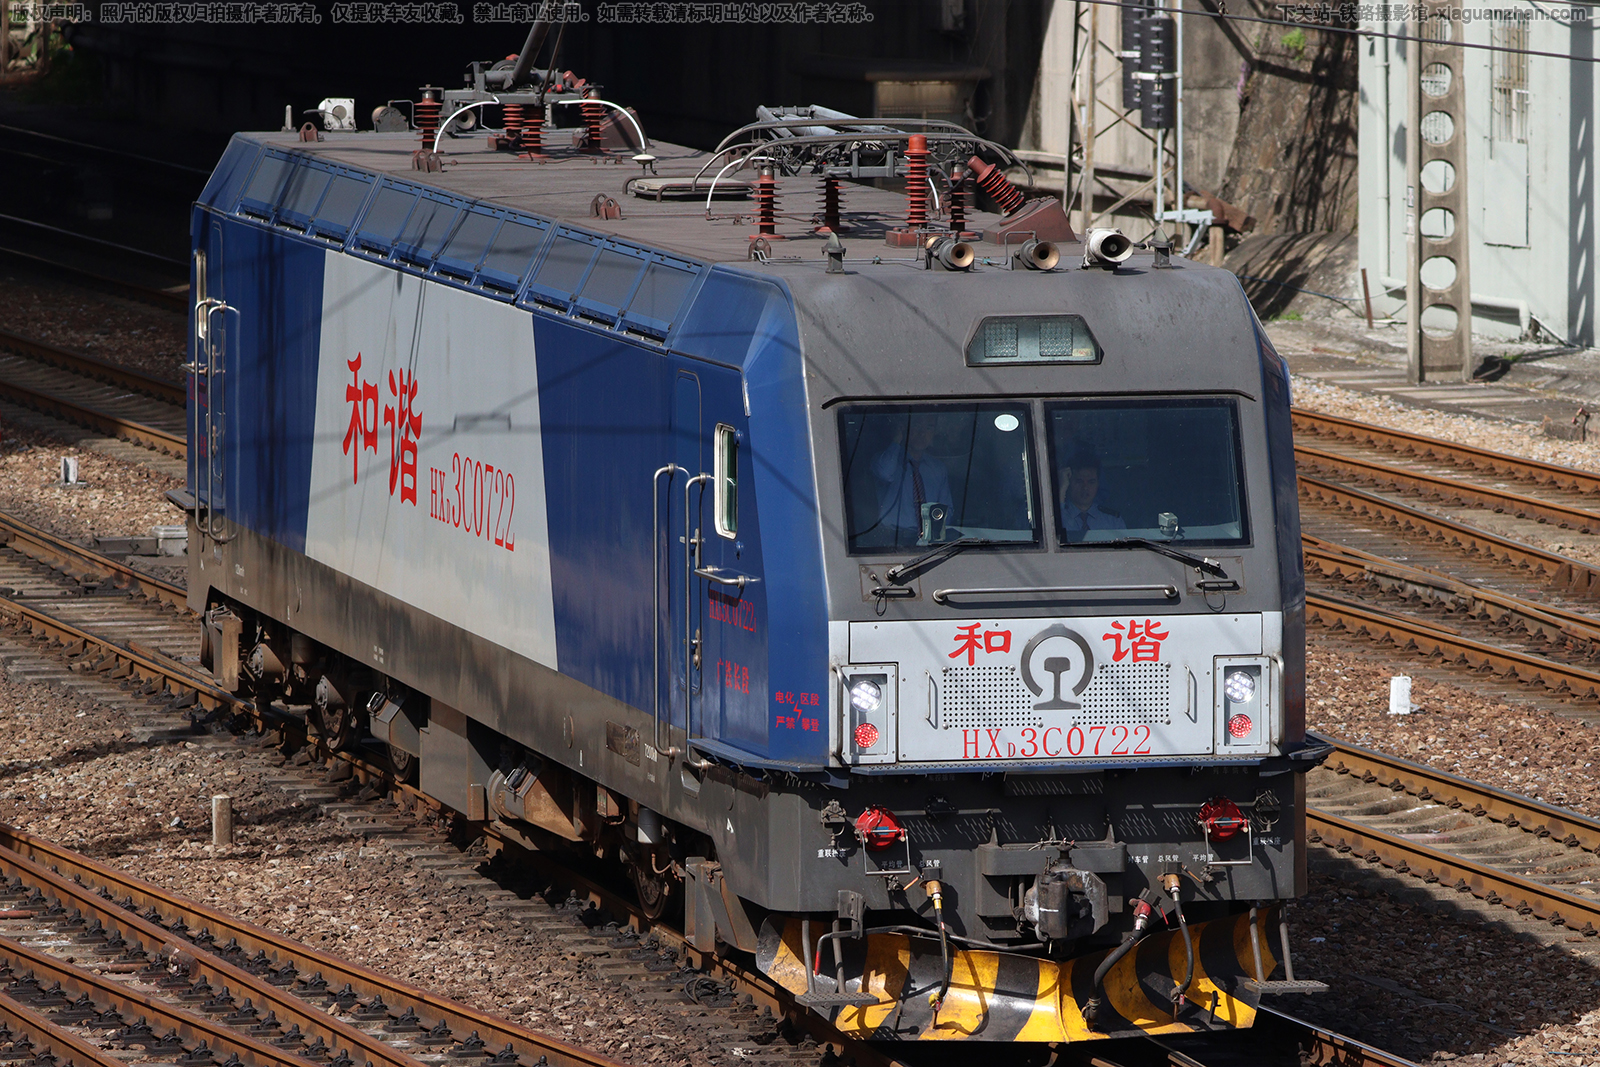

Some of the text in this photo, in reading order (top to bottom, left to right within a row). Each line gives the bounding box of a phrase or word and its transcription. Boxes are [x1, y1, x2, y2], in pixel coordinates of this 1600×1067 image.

[342, 351, 423, 507] 和谐
[430, 452, 515, 552] HXD3C0722
[948, 619, 1170, 667] 和 谐
[775, 690, 820, 706] 电化 区段
[775, 715, 796, 730] 严禁
[962, 724, 1151, 759] HXD3C0722
